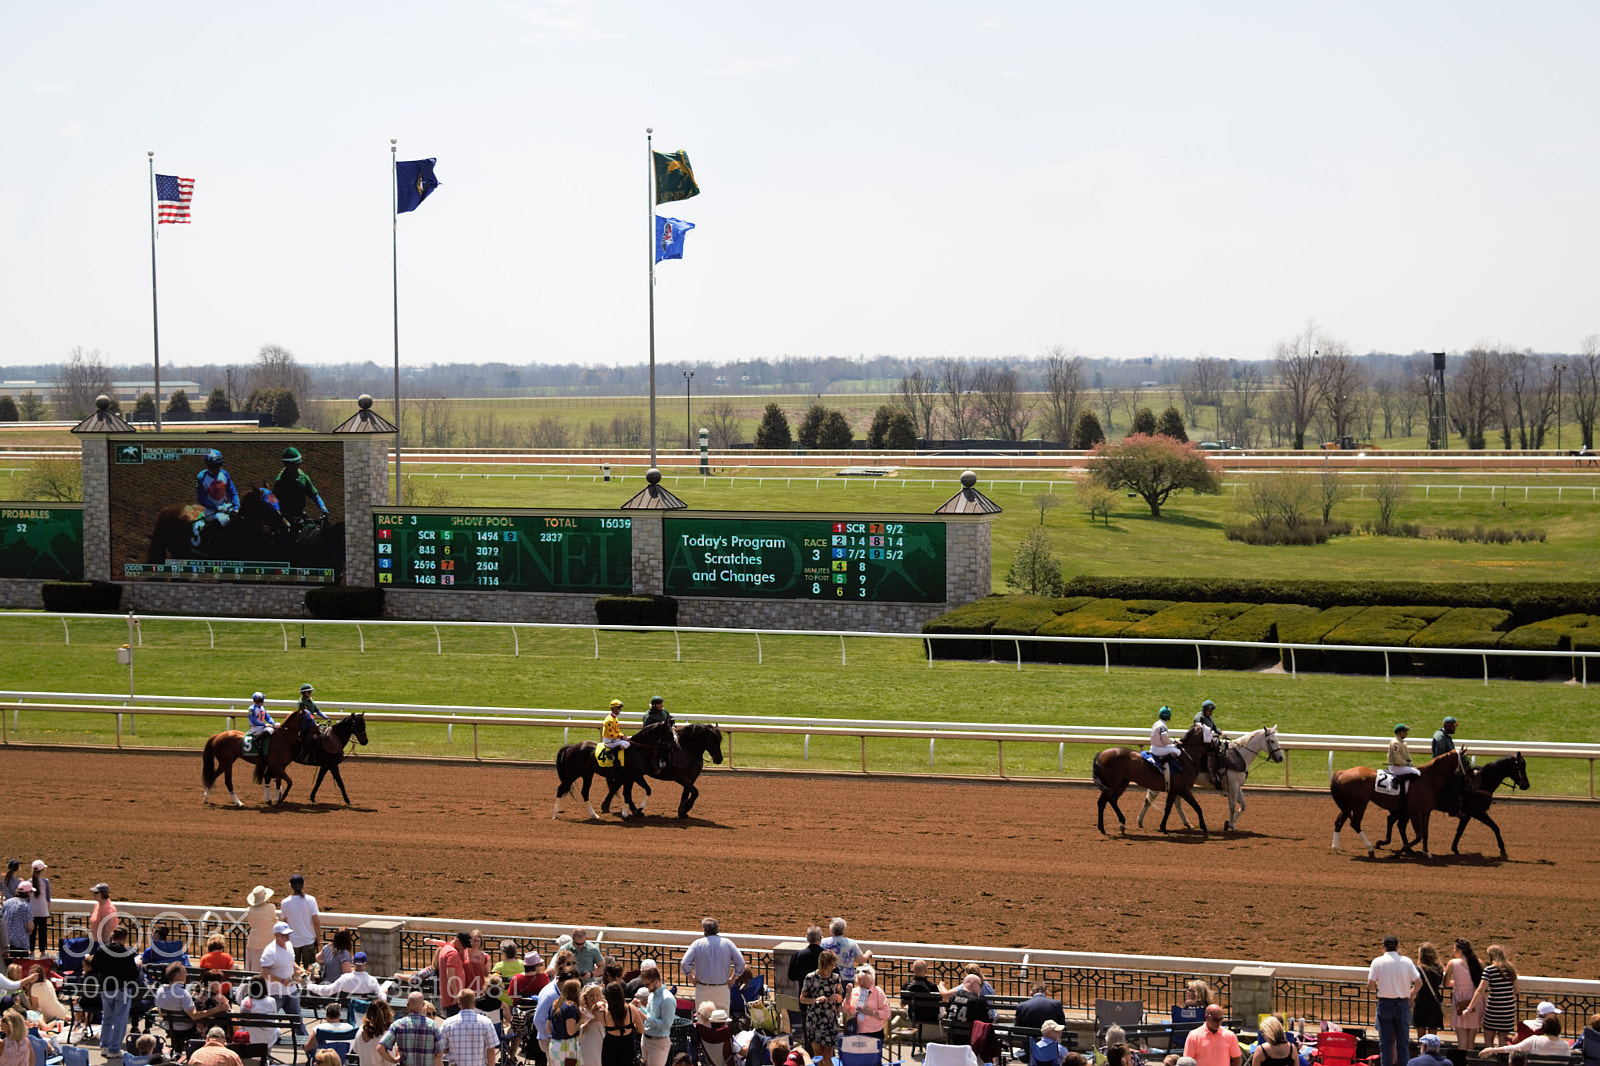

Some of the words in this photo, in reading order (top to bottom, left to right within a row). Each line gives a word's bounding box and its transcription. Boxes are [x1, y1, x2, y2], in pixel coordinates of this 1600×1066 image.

[2, 510, 50, 519] PROBABLES
[378, 515, 403, 524] RACE
[410, 516, 417, 525] 3
[486, 517, 514, 526] POOL
[544, 518, 578, 528] TOTAL
[600, 518, 632, 528] 16039
[16, 524, 28, 532] 52
[836, 524, 842, 532] 1
[846, 524, 866, 533] SCR
[874, 524, 880, 533] 7
[886, 524, 903, 534] 9/2
[382, 530, 388, 539] 1
[418, 530, 436, 540] SCR
[444, 531, 450, 540] 5
[508, 532, 514, 540] 9
[682, 534, 728, 550] Today's
[731, 535, 786, 550] Program
[804, 538, 828, 547] RACE
[836, 536, 843, 545] 2
[874, 536, 880, 546] 8
[382, 544, 388, 553] 2
[444, 546, 450, 555] 6
[812, 549, 820, 560] 3
[836, 549, 843, 558] 3
[848, 549, 866, 560] 7/2
[874, 550, 880, 558] 9
[886, 550, 903, 560] 5/2
[704, 552, 762, 564] Scratches
[382, 560, 388, 568] 3
[445, 561, 450, 570] 7
[836, 562, 843, 570] 4
[860, 562, 866, 572] 8
[383, 574, 388, 583] 4
[444, 575, 450, 584] 8
[692, 570, 716, 582] and
[720, 570, 776, 586] Changes
[836, 575, 843, 584] 5
[860, 575, 866, 584] 9
[812, 582, 820, 594] 8
[836, 587, 844, 596] 6
[860, 588, 866, 597] 3
[597, 748, 606, 764] 4
[1377, 773, 1388, 788] 2
